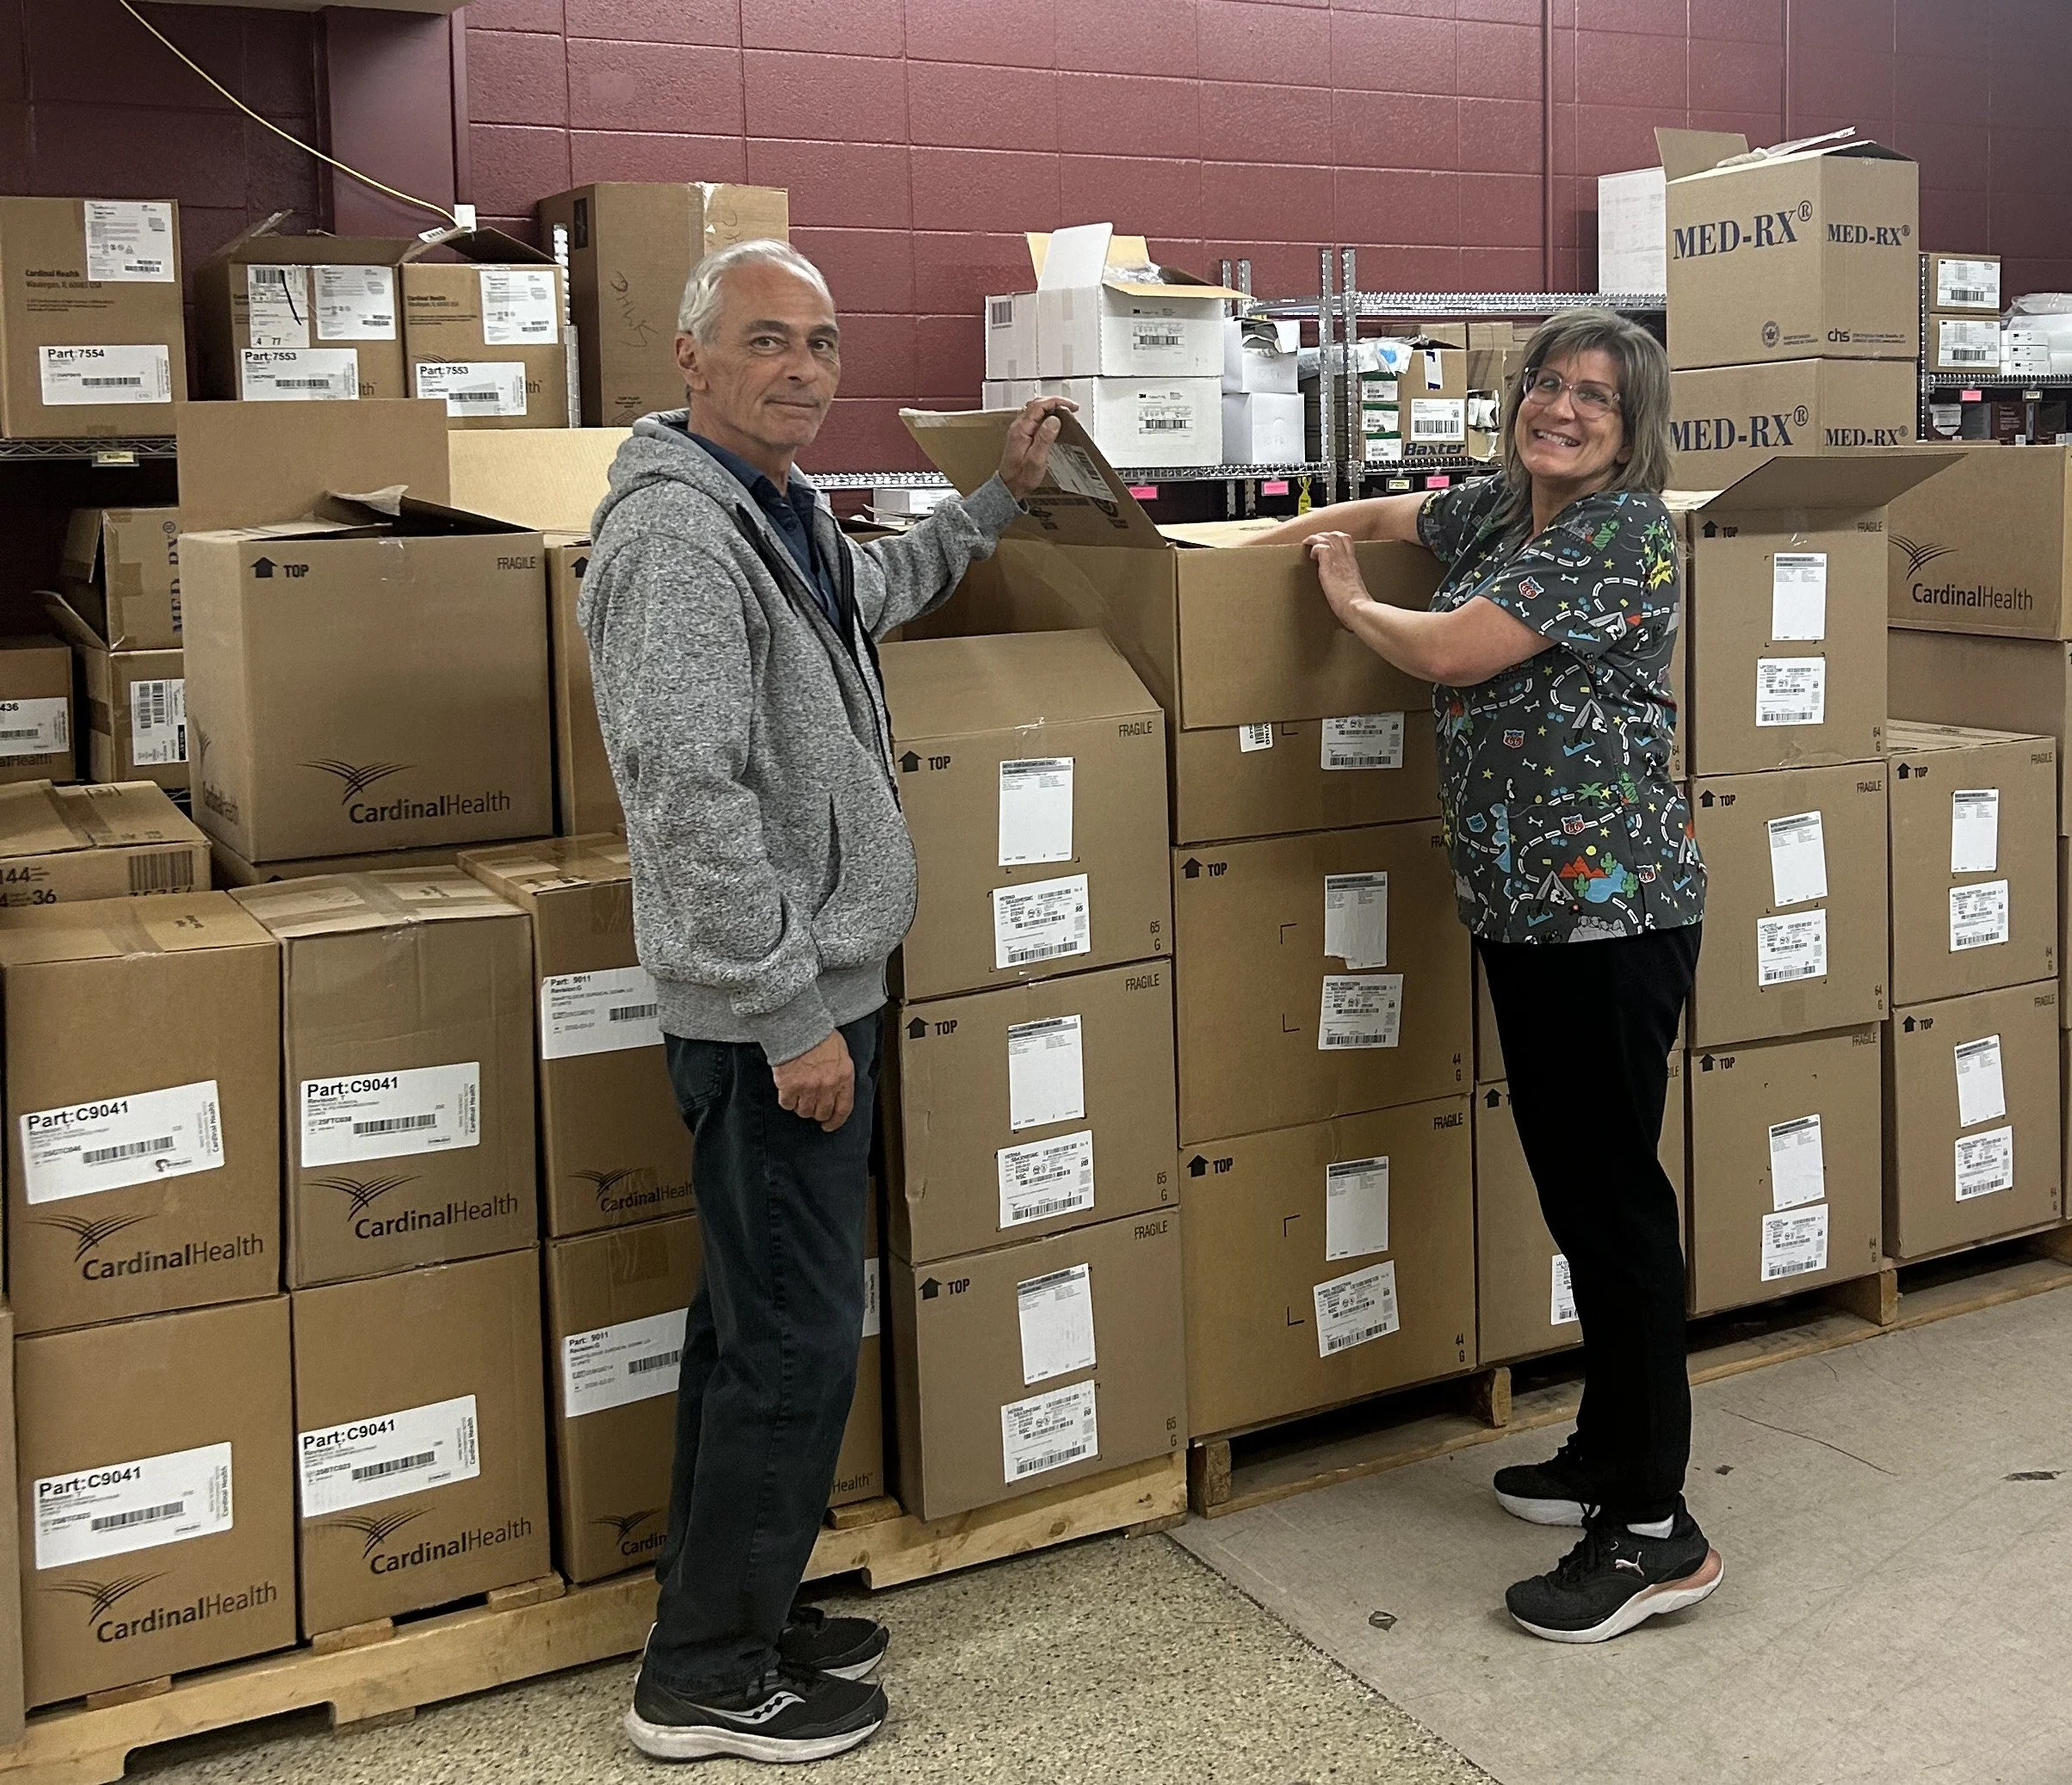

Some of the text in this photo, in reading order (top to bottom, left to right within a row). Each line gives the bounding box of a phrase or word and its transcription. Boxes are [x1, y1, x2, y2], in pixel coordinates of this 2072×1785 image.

[1404, 442, 1466, 457] Baxter
[1723, 526, 1738, 539] TOP
[1857, 521, 1883, 534] FRAGILE
[497, 556, 537, 571] FRAGILE
[283, 564, 309, 578] TOP
[1911, 582, 2034, 612] CardinalHealth
[1118, 721, 1153, 738] FRAGILE
[928, 757, 951, 771] TOP
[1914, 767, 1928, 779] TOP
[1856, 781, 1883, 794] FRAGILE
[349, 790, 511, 825] CardinalHealth
[1719, 794, 1736, 807] TOP
[1207, 862, 1228, 876] TOP
[1149, 921, 1160, 934] 65
[1154, 939, 1161, 951] G
[1125, 973, 1160, 991] FRAGILE
[1874, 985, 1883, 996] 64
[935, 1020, 958, 1036] TOP
[1919, 1017, 1933, 1031] TOP
[1452, 1052, 1462, 1065] 44
[1719, 1057, 1736, 1071] TOP
[1456, 1069, 1462, 1081] G
[1433, 1112, 1463, 1131] FRAGILE
[1213, 1157, 1234, 1174] TOP
[1157, 1171, 1167, 1184] 65
[1161, 1189, 1168, 1201] G
[354, 1193, 518, 1240] CardinalHealth
[1134, 1220, 1168, 1240] FRAGILE
[82, 1233, 264, 1282] CardinalHealth
[947, 1278, 970, 1295] TOP
[1166, 1417, 1177, 1430] 65
[1170, 1435, 1177, 1447] G
[369, 1516, 532, 1576] CardinalHealth
[96, 1578, 278, 1644] CardinalHealth
